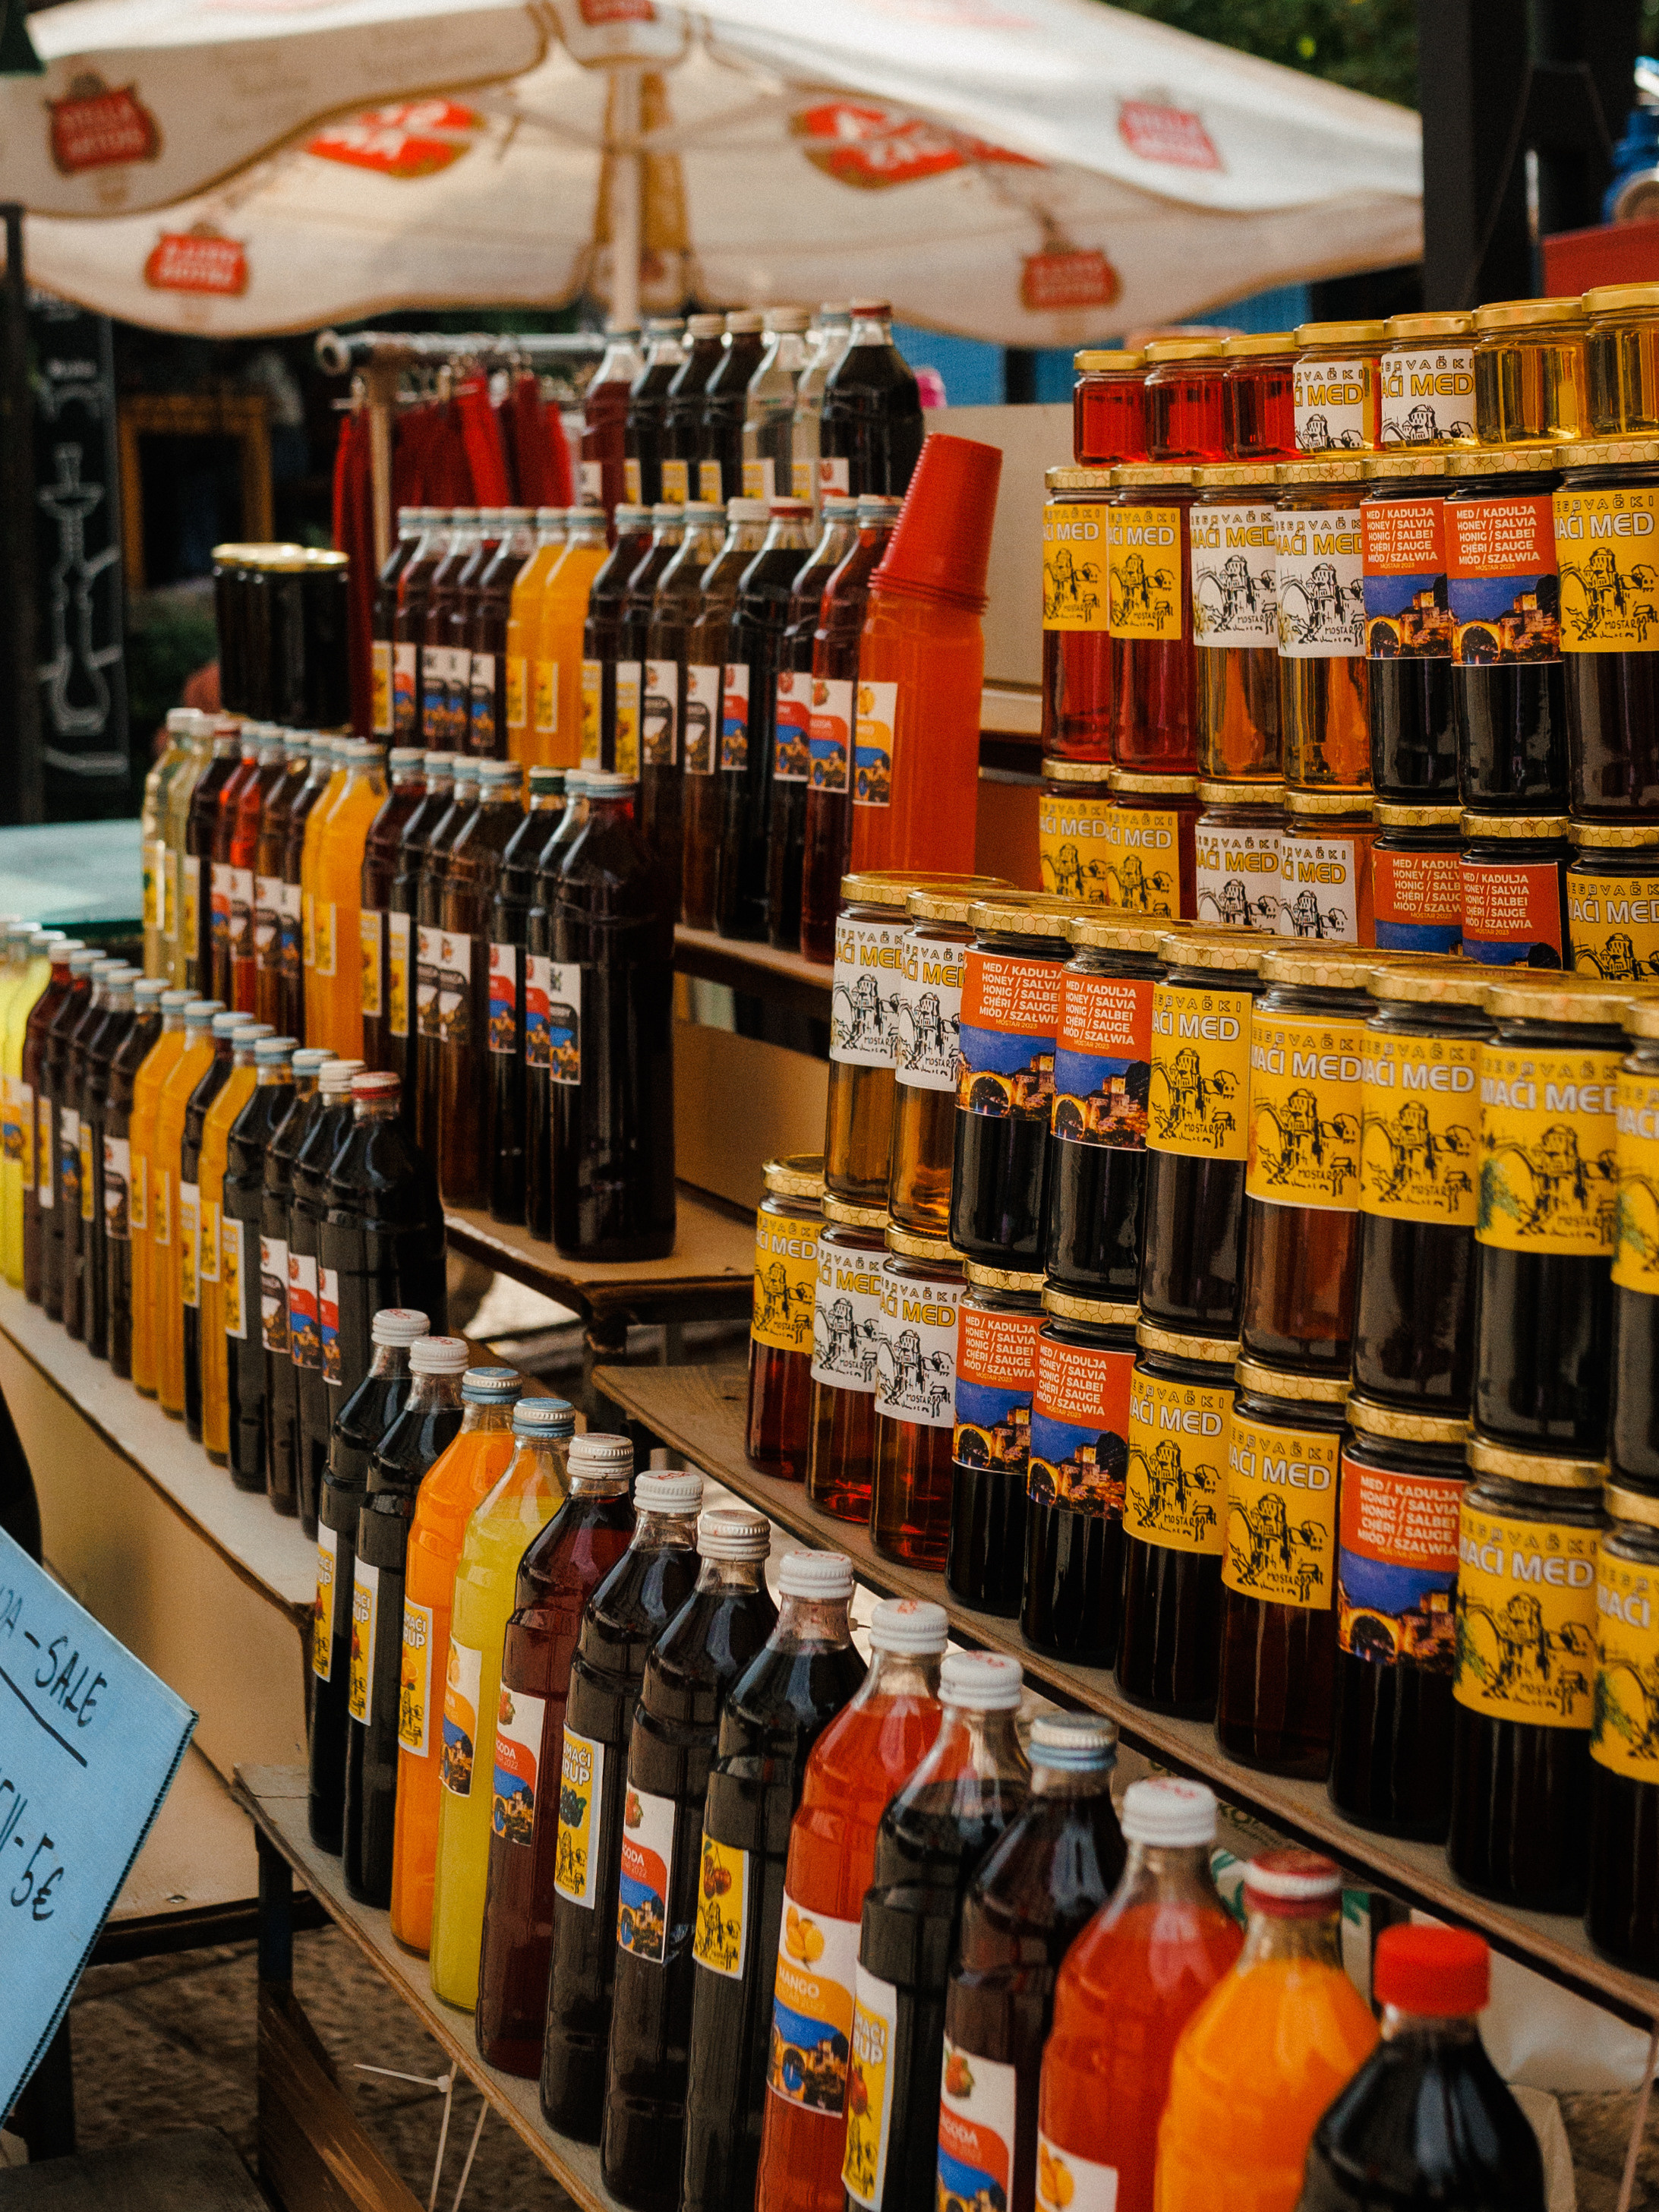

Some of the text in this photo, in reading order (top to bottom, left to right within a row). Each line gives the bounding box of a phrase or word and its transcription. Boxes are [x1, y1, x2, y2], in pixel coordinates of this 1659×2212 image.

[1307, 383, 1363, 405] MED
[1411, 374, 1474, 396] MED
[1367, 508, 1434, 519] MED KADULJA
[1457, 506, 1536, 519] MED KADULJA
[1057, 522, 1099, 541] MED
[1367, 519, 1435, 531] HONEY SALVIA
[1458, 518, 1537, 531] HONEY SALVIA
[1590, 512, 1654, 538] MED
[1127, 526, 1175, 546] MED
[1369, 530, 1433, 541] HONIG SALBEI
[1459, 529, 1535, 542] HONIG SALBEI
[1397, 541, 1431, 551] SAUGE
[1461, 541, 1534, 554] CHÉRI SAUGE
[1459, 552, 1540, 565] MIÓD SZAŁWIA
[1061, 819, 1106, 838] MED
[1124, 828, 1172, 848] MED
[1225, 852, 1279, 872] MED
[1392, 859, 1411, 869] MED
[1298, 862, 1345, 884] MED
[1393, 870, 1424, 880] HONEY
[1482, 874, 1528, 884] KADULJA
[1396, 881, 1460, 891] HONIG SALB
[1464, 885, 1529, 895] HONEY SALVIA
[1396, 891, 1424, 901] CHÉRI
[1465, 895, 1528, 906] HONIG SALBEI
[1394, 902, 1416, 911] MIÓD
[1491, 909, 1526, 917] SAUGE
[982, 973, 1014, 986] HONEY
[983, 962, 1062, 980] MED KADULJA
[983, 985, 1012, 997] HONIG
[1066, 980, 1137, 998] MED KADULJA
[983, 996, 1058, 1013] CHÉRI SAUGE
[1066, 992, 1136, 1010] HONEY SALVIA
[979, 1006, 1001, 1018] MIÓD
[1066, 1004, 1133, 1021] HONIG SALBEI
[1066, 1015, 1130, 1033] CHÉRI SAUGE
[1179, 1013, 1240, 1041] MED
[1064, 1027, 1134, 1045] MIÓD SZAŁWIA
[1293, 1052, 1362, 1082] MED
[1402, 1062, 1474, 1092] MED
[771, 1235, 817, 1261] MED
[903, 1301, 955, 1327] MED
[966, 1315, 1036, 1334] MED KADULJA
[966, 1327, 1036, 1346] HONEY SALVIA
[966, 1338, 1033, 1355] HONIG SALBEI
[967, 1349, 1031, 1367] CHÉRI SAUGE
[1040, 1345, 1107, 1370] MED KADULJA
[964, 1359, 1035, 1378] MIÓD SZAŁWIA
[1039, 1356, 1106, 1381] HONEY SALVIA
[1039, 1368, 1103, 1392] HONIG SALBEI
[1039, 1380, 1100, 1403] CHÉRI SAUGE
[1037, 1390, 1105, 1415] MIÓD SZAŁWIA
[1160, 1406, 1222, 1436] MED
[1263, 1457, 1330, 1490] MED
[1512, 1551, 1594, 1588] MED
